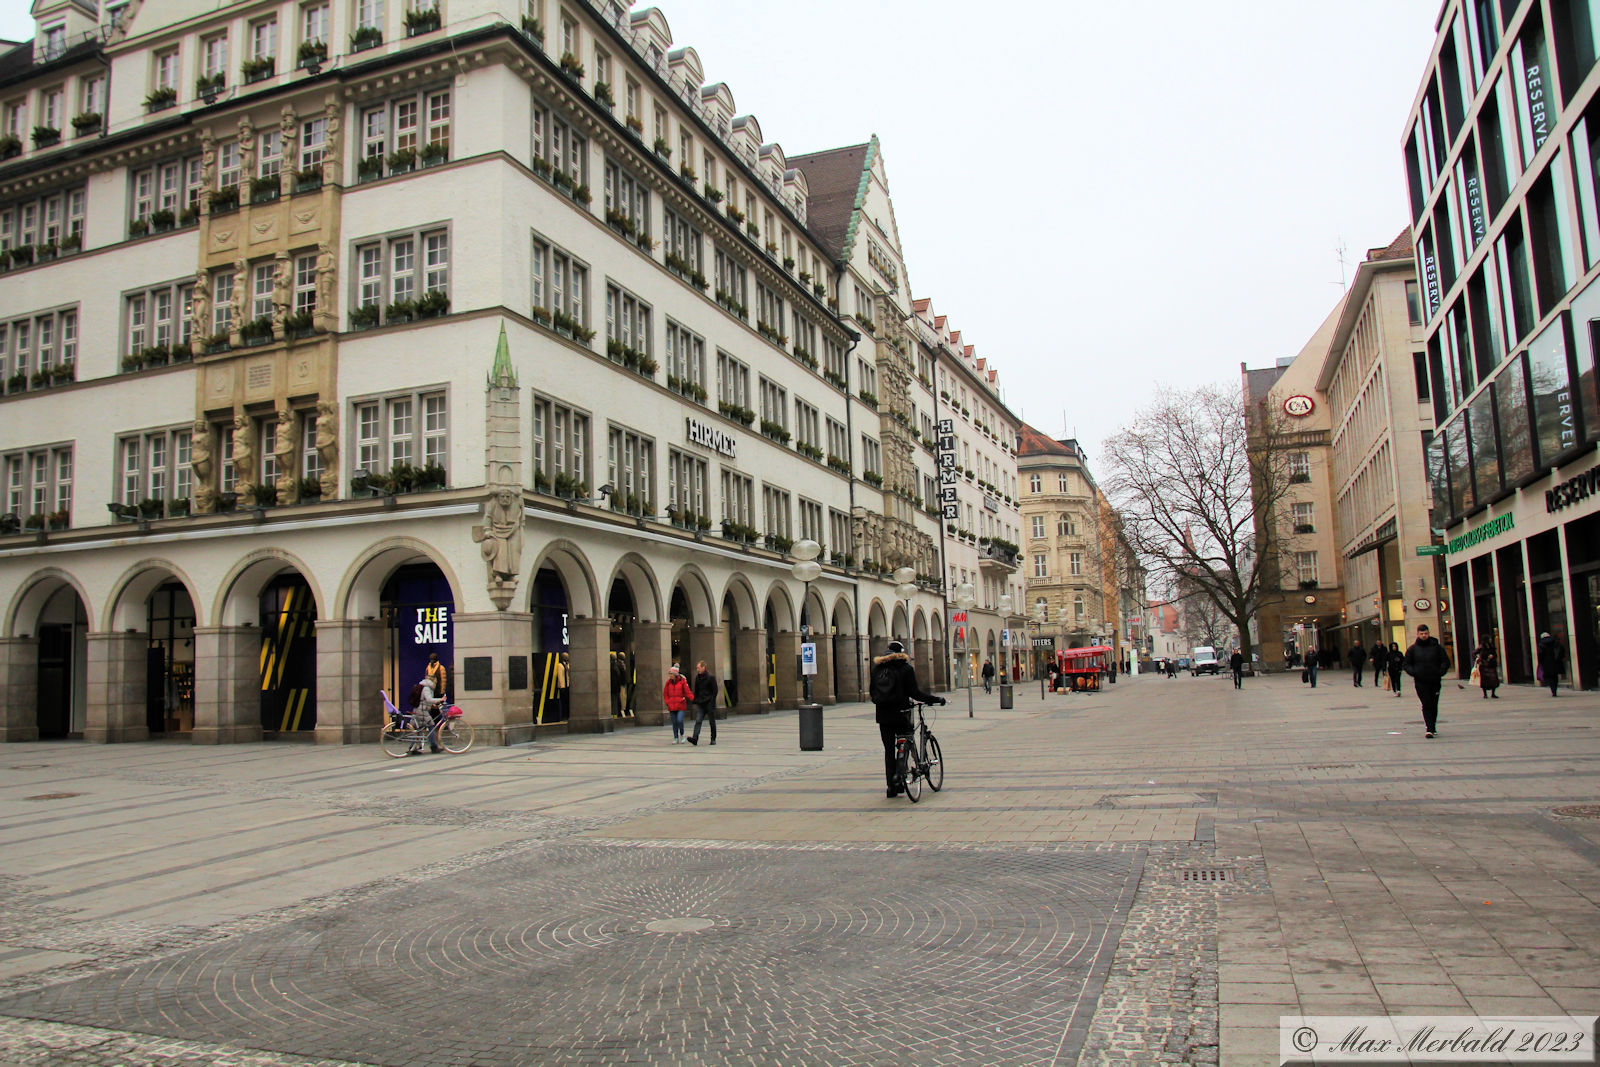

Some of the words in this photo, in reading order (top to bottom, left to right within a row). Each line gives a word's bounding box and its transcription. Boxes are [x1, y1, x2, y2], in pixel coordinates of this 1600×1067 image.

[1288, 400, 1309, 411] C&A
[686, 417, 736, 458] HIRMER
[940, 420, 957, 518] HIRMER
[416, 607, 448, 623] THE
[414, 623, 448, 645] SALE
